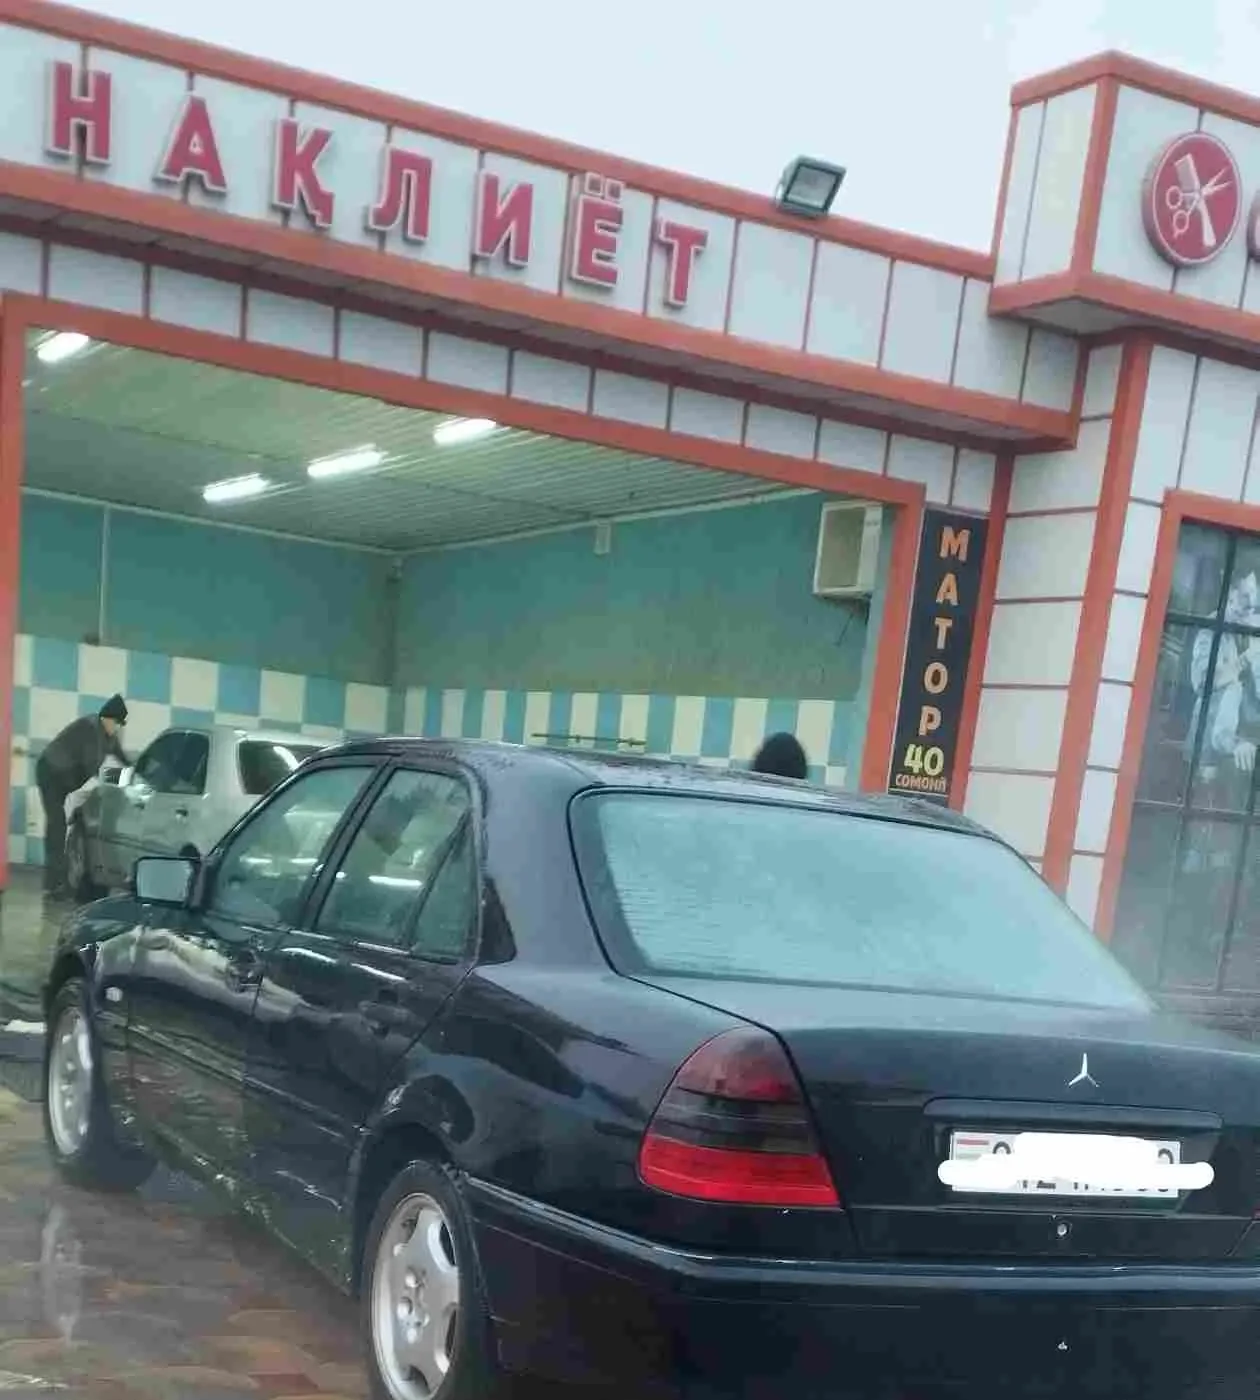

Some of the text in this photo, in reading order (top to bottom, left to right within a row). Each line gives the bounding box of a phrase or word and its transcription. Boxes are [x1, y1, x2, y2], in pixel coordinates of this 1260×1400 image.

[47, 60, 708, 306] НАҚЛИЁТ
[917, 526, 971, 736] МАТОР
[903, 743, 945, 776] 40
